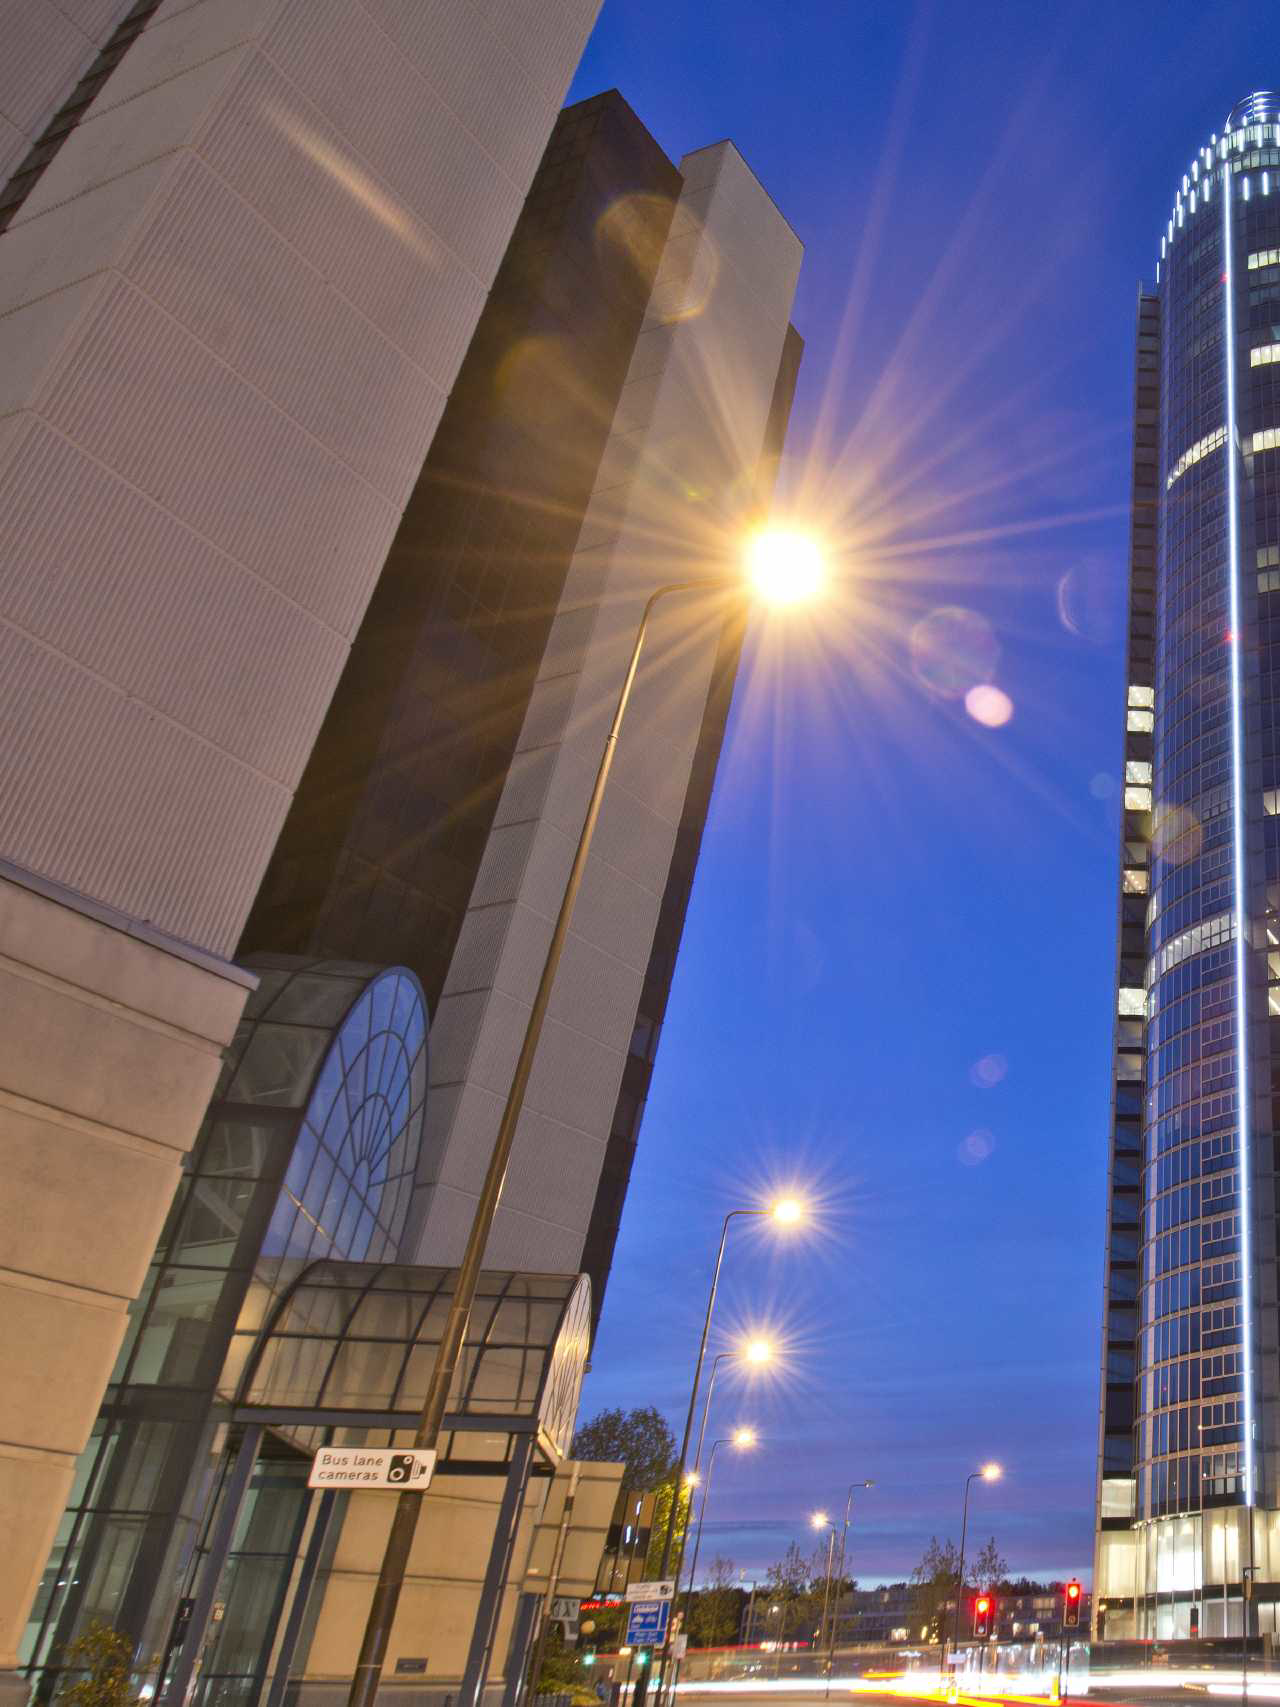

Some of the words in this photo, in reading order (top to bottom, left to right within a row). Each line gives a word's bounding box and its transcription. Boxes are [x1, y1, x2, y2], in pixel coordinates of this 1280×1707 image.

[321, 1454, 349, 1466] Bus
[353, 1455, 384, 1466] lane
[318, 1470, 379, 1481] cameras
